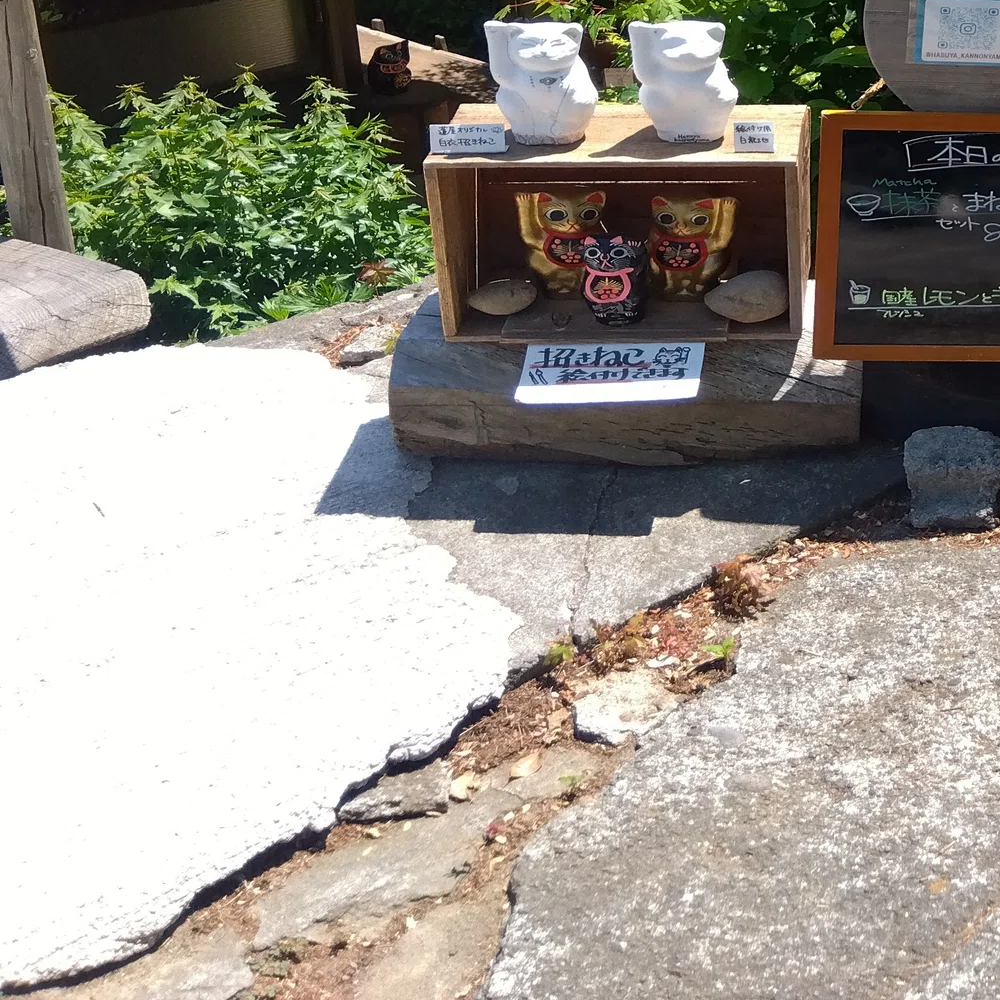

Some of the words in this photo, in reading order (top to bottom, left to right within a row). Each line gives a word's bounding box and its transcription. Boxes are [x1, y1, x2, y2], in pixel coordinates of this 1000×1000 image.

[873, 177, 938, 188] Matcha
[536, 346, 645, 369] 招きねこ
